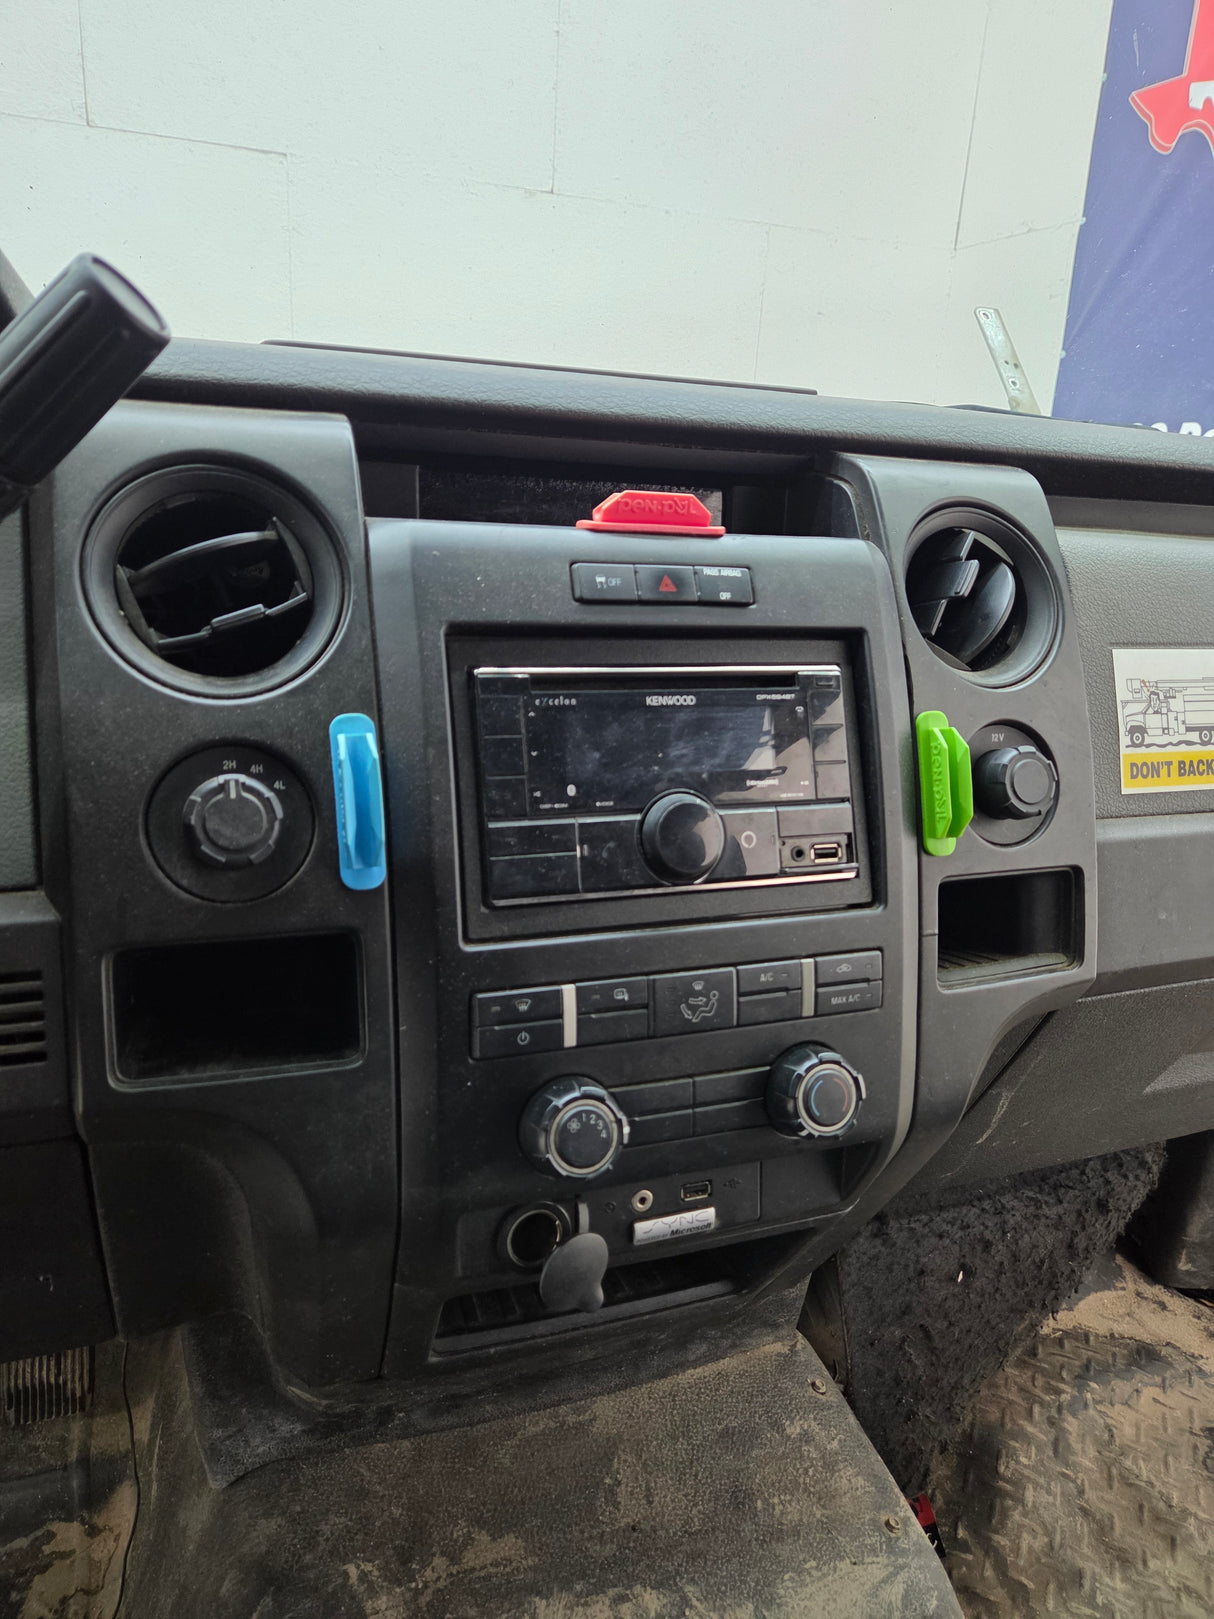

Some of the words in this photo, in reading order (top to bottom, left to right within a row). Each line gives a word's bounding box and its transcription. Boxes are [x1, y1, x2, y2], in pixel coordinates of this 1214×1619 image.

[703, 568, 719, 577] PASS
[720, 569, 742, 577] AIRBAG
[608, 578, 622, 586] OFF
[719, 591, 732, 600] OFF
[645, 695, 697, 706] KENWOOD
[222, 759, 237, 770] 2H
[249, 763, 264, 774] 4H
[273, 780, 286, 790] 4L
[1129, 760, 1174, 780] DON'T
[1177, 758, 1214, 777] BACK
[760, 972, 774, 982] A/C
[831, 996, 847, 1005] MAX
[848, 994, 861, 1003] A/C
[590, 1113, 597, 1125] 2
[597, 1119, 604, 1130] 3
[642, 1210, 712, 1235] SYNC
[669, 1222, 713, 1237] Microsoft
